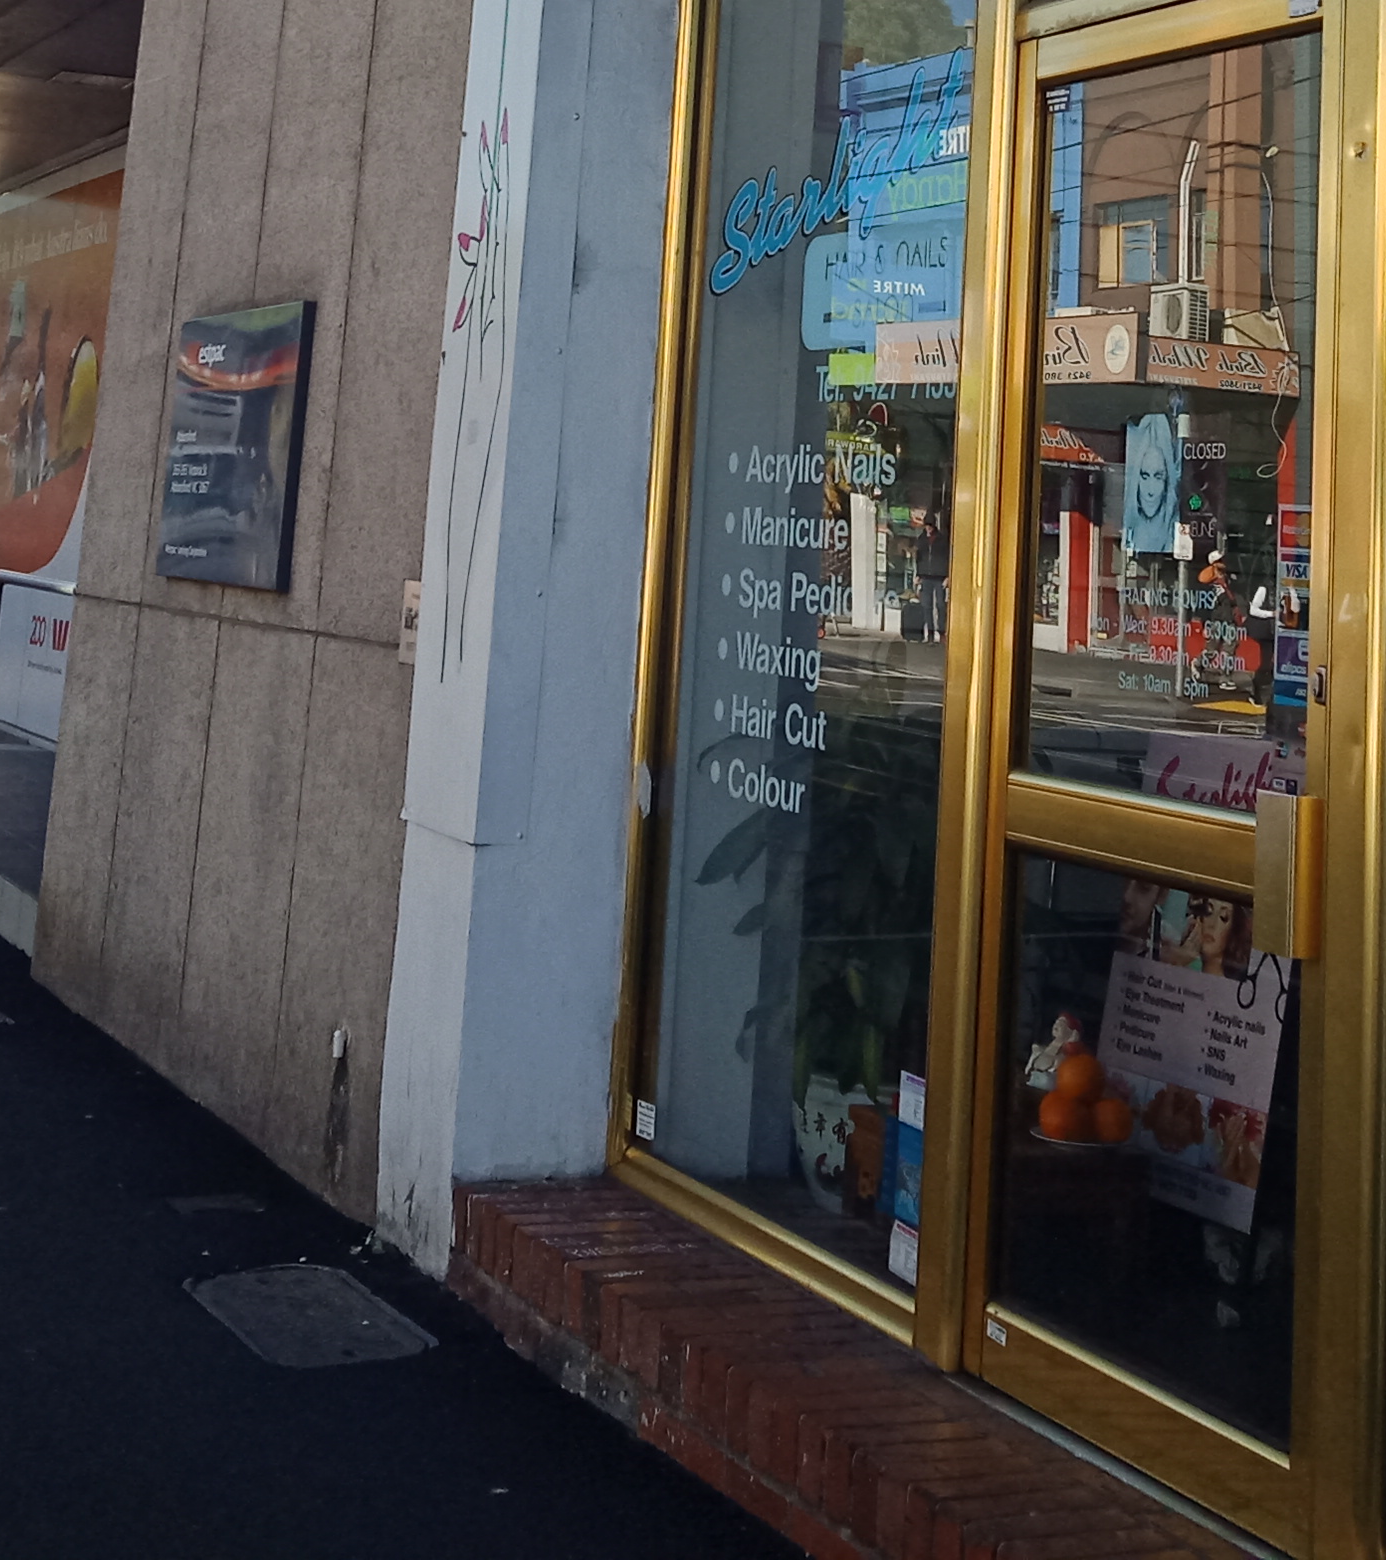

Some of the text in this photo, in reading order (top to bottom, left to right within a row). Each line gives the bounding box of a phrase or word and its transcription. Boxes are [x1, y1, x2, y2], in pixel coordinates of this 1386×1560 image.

[710, 47, 964, 297] Starlight
[894, 236, 949, 270] NAILS
[746, 445, 897, 494] Acrylic Nails
[1183, 442, 1227, 461] CLOSED
[741, 506, 849, 551] Manicure
[738, 567, 782, 618] Spa
[1285, 563, 1308, 579] VISA
[736, 630, 822, 693] Waxing
[731, 694, 827, 752] Hair Cut
[727, 758, 806, 814] Colour
